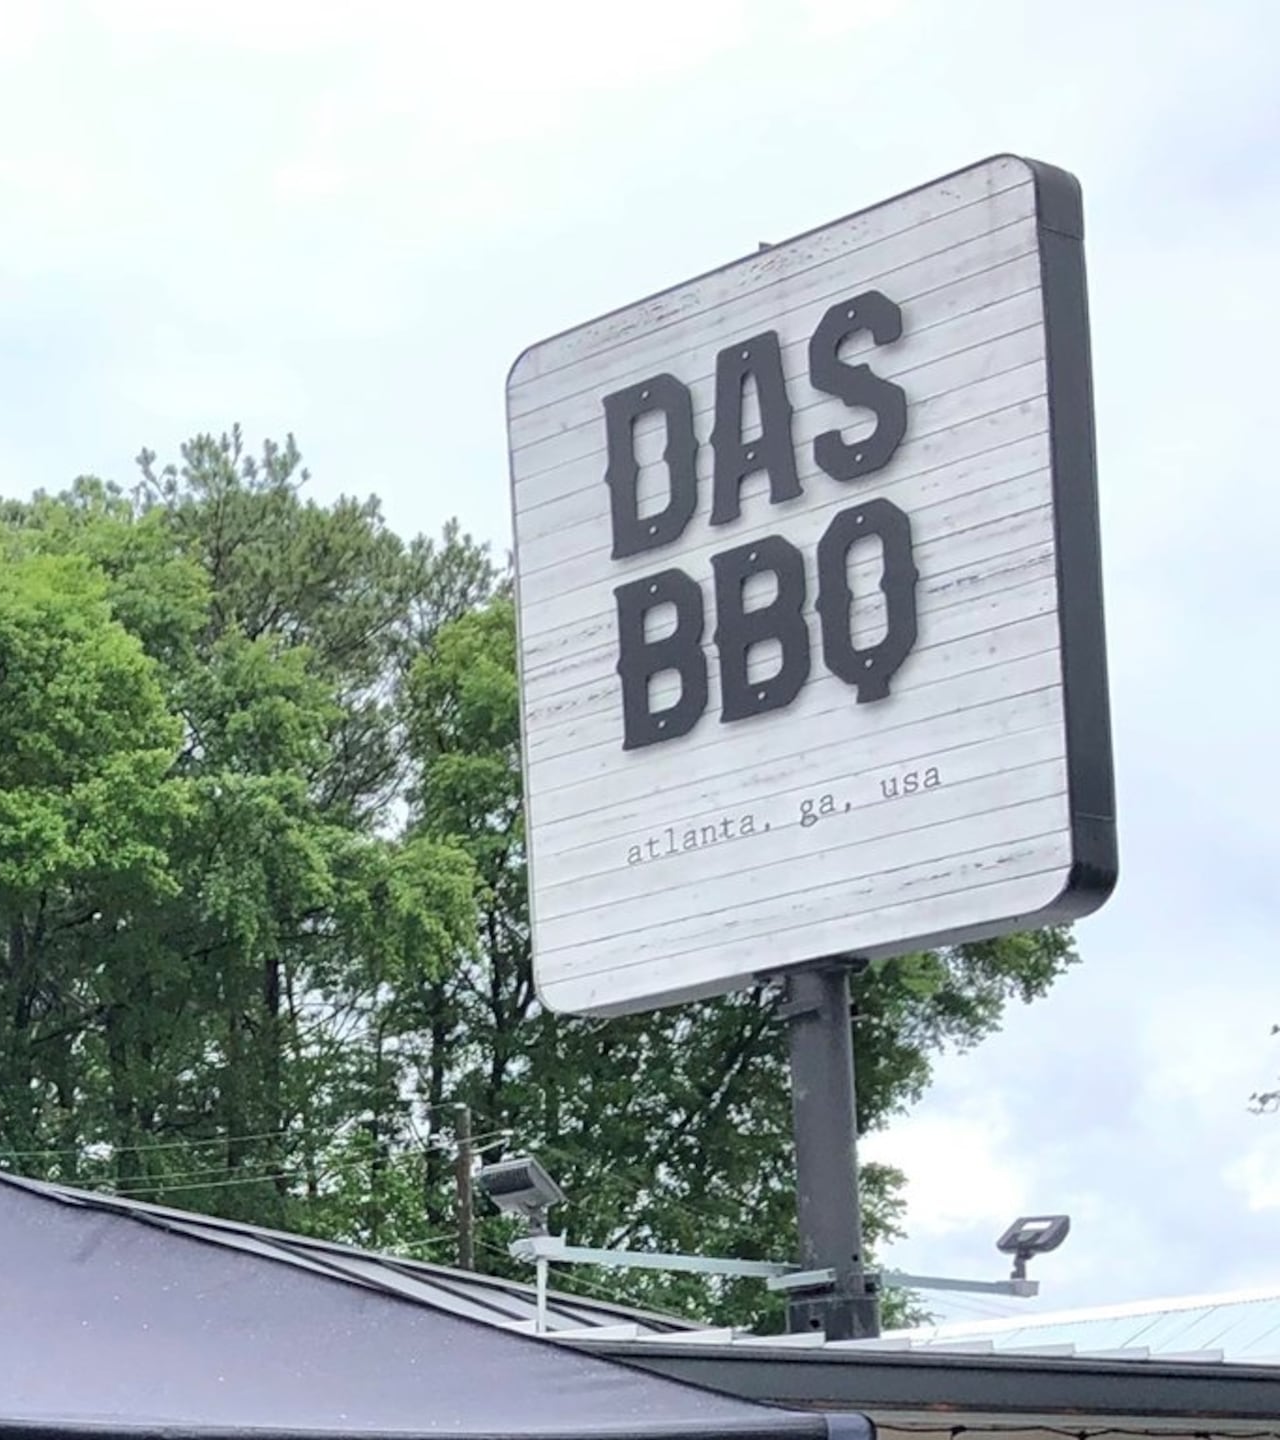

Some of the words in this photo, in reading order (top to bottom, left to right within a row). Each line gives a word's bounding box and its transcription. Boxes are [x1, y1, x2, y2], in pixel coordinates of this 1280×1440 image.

[602, 290, 908, 560] DAS
[613, 497, 920, 751] BBQ
[627, 813, 772, 867] atlanta,
[799, 793, 852, 828] ga,
[880, 766, 942, 800] usa
